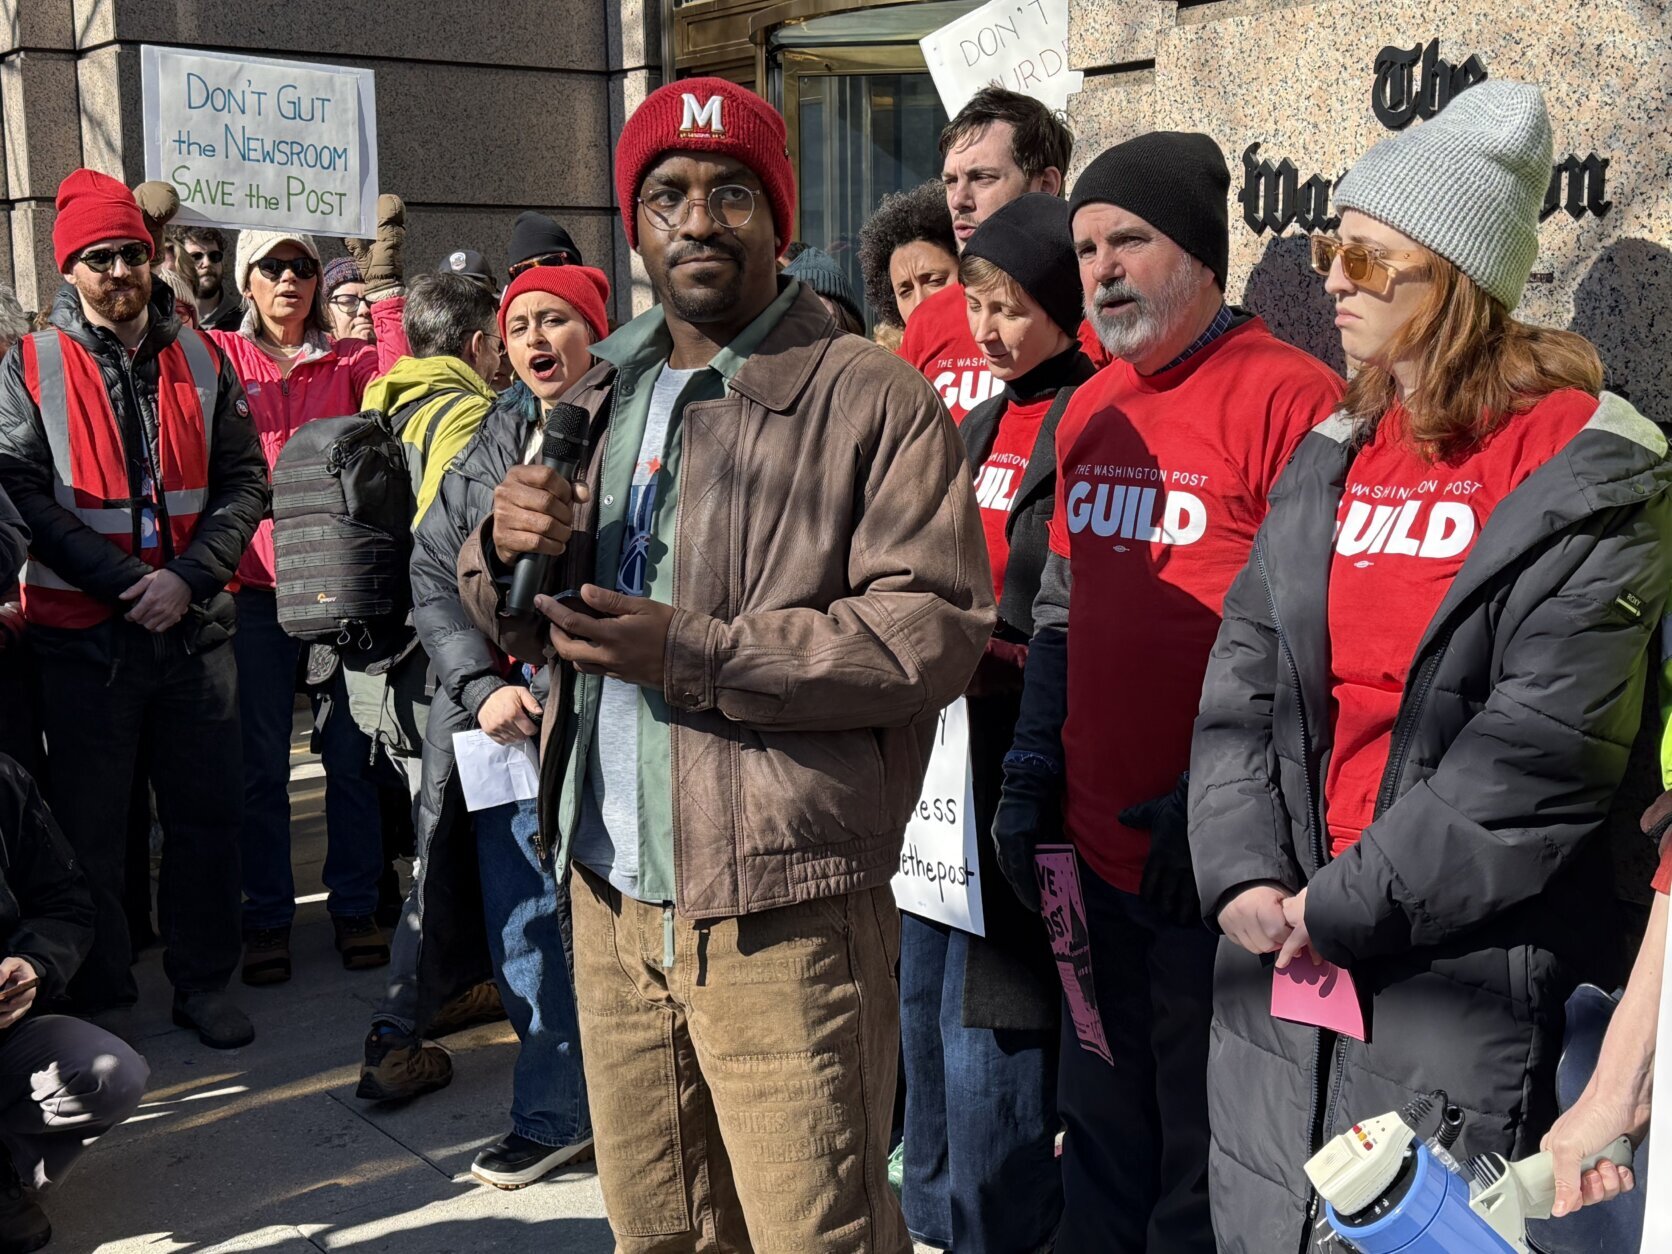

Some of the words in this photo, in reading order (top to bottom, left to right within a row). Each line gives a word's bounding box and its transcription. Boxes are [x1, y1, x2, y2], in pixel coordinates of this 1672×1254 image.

[960, 0, 1048, 67] DON'T
[187, 72, 268, 117] DON'T
[276, 84, 331, 123] GUT
[679, 93, 724, 133] M
[172, 130, 216, 158] the
[224, 123, 348, 171] NEWSROOM
[172, 165, 235, 207] SAVE
[244, 183, 280, 210] the
[286, 175, 347, 217] POST
[937, 358, 954, 368] THE
[1075, 464, 1092, 476] THE
[1094, 465, 1168, 483] WASHINGTON
[1171, 471, 1209, 487] POST
[1443, 480, 1483, 496] POST
[1066, 480, 1208, 546] GUILD
[1332, 499, 1475, 559] UILD
